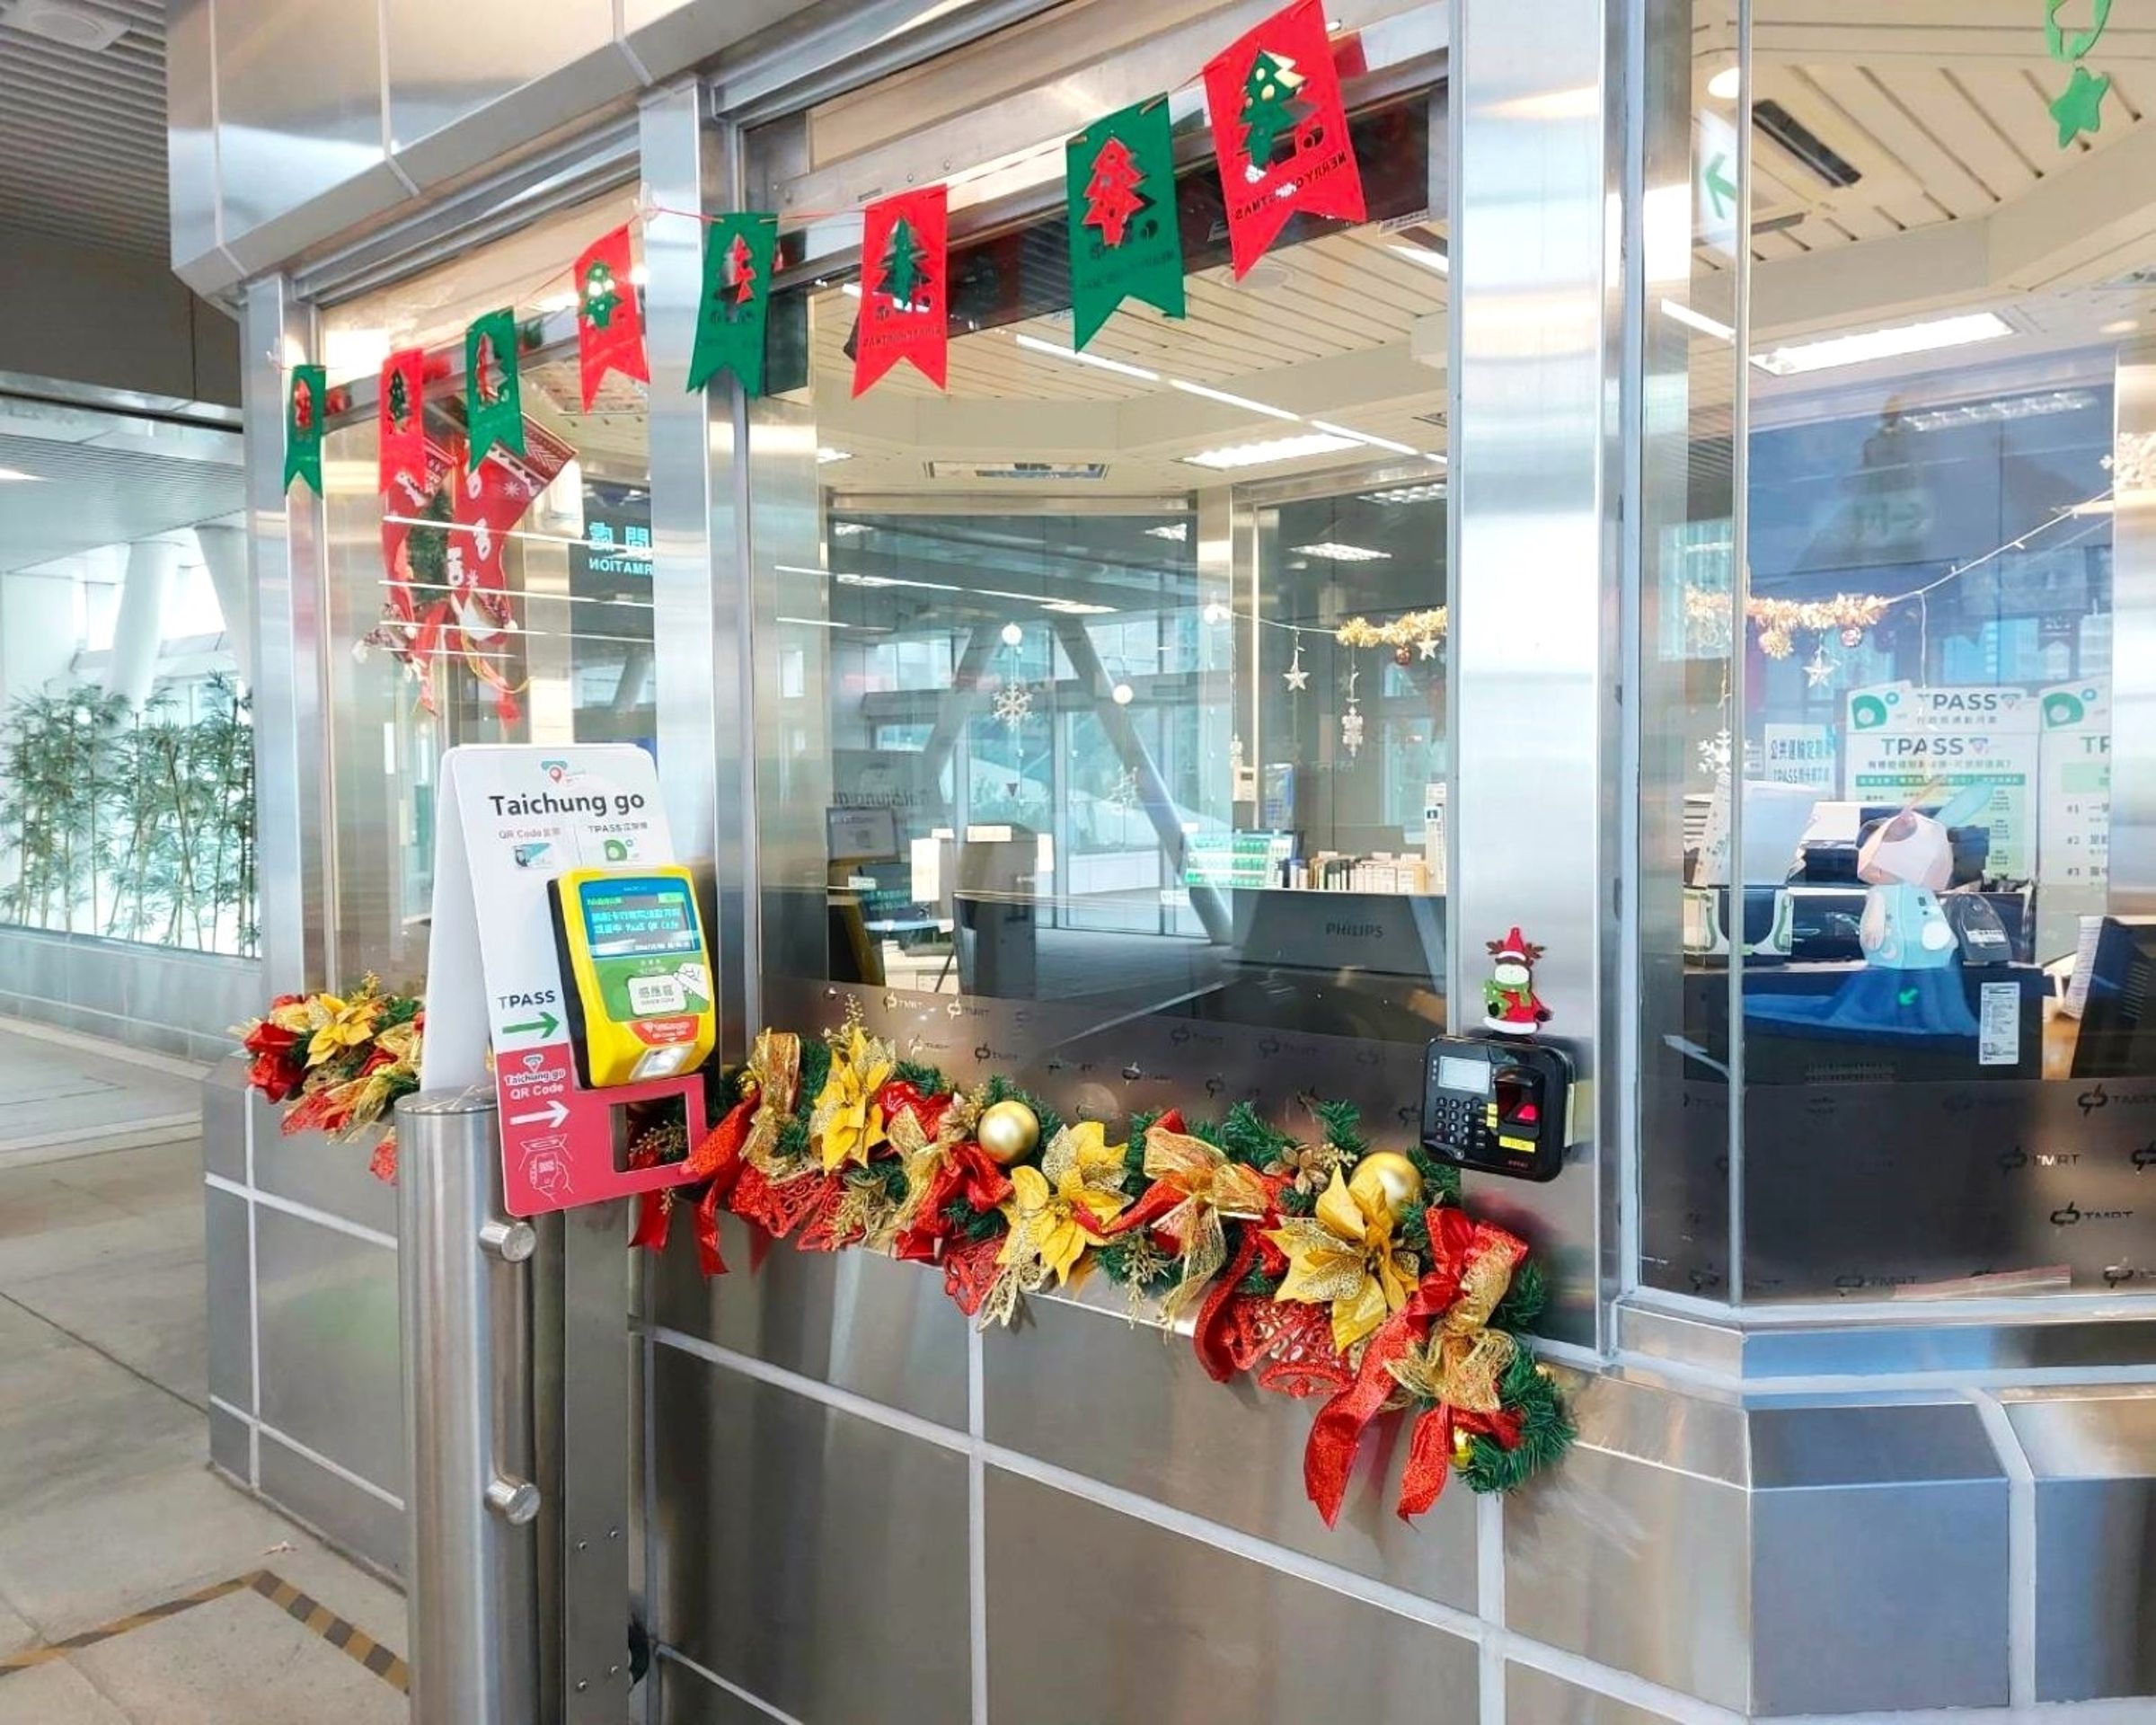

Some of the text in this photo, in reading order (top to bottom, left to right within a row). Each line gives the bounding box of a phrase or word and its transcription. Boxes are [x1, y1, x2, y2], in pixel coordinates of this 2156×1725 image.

[1881, 738, 1965, 756] TPASS
[488, 791, 645, 817] Taichung go
[1325, 922, 1383, 939] PHILIPS
[496, 990, 556, 1010] TPASS
[505, 1072, 551, 1085] Taichung
[509, 1084, 565, 1101] QR Code
